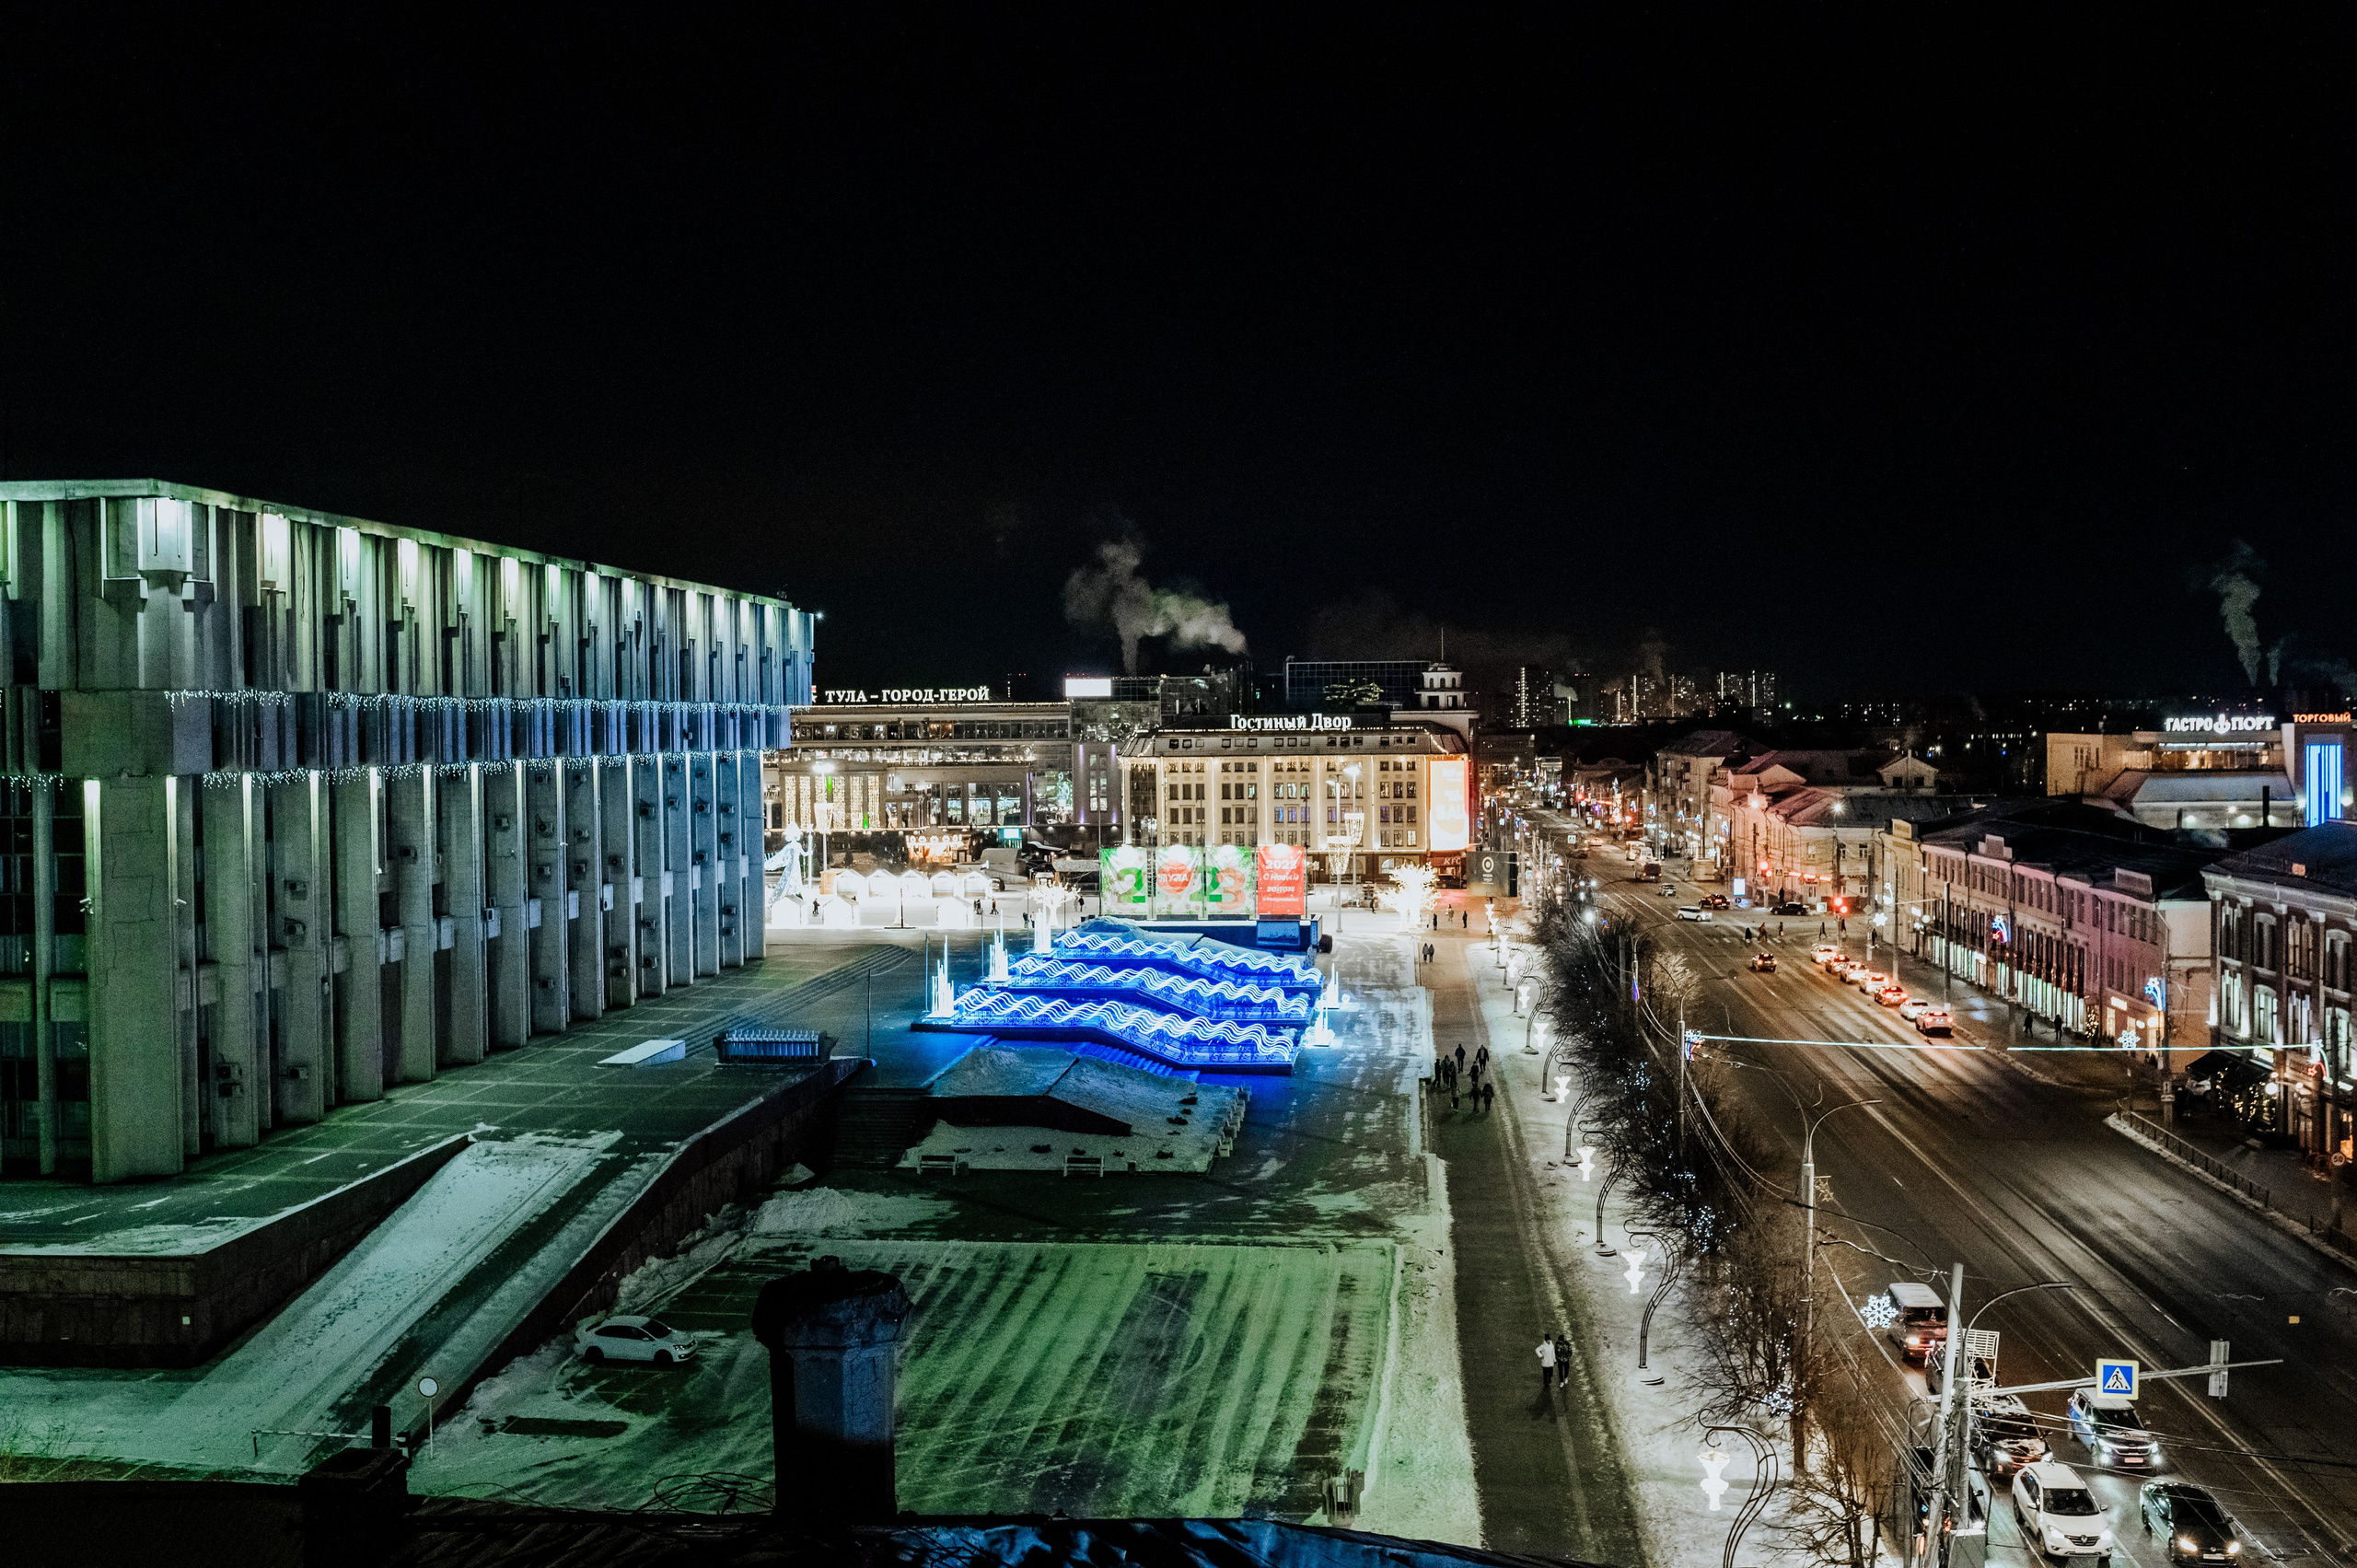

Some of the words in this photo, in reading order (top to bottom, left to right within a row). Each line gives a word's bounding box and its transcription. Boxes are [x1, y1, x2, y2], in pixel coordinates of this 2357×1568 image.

[825, 690, 867, 703] ТУЛА
[881, 685, 990, 703] ГОРОД-ГЕРОЙ
[1230, 714, 1306, 729] Гостиный
[1310, 713, 1352, 731] Двор
[2165, 717, 2213, 732] ГАСТРО
[2231, 716, 2275, 730] ПОРТ
[2293, 712, 2351, 723] ТОРГОВЫЙ
[2332, 1155, 2343, 1163] 50
